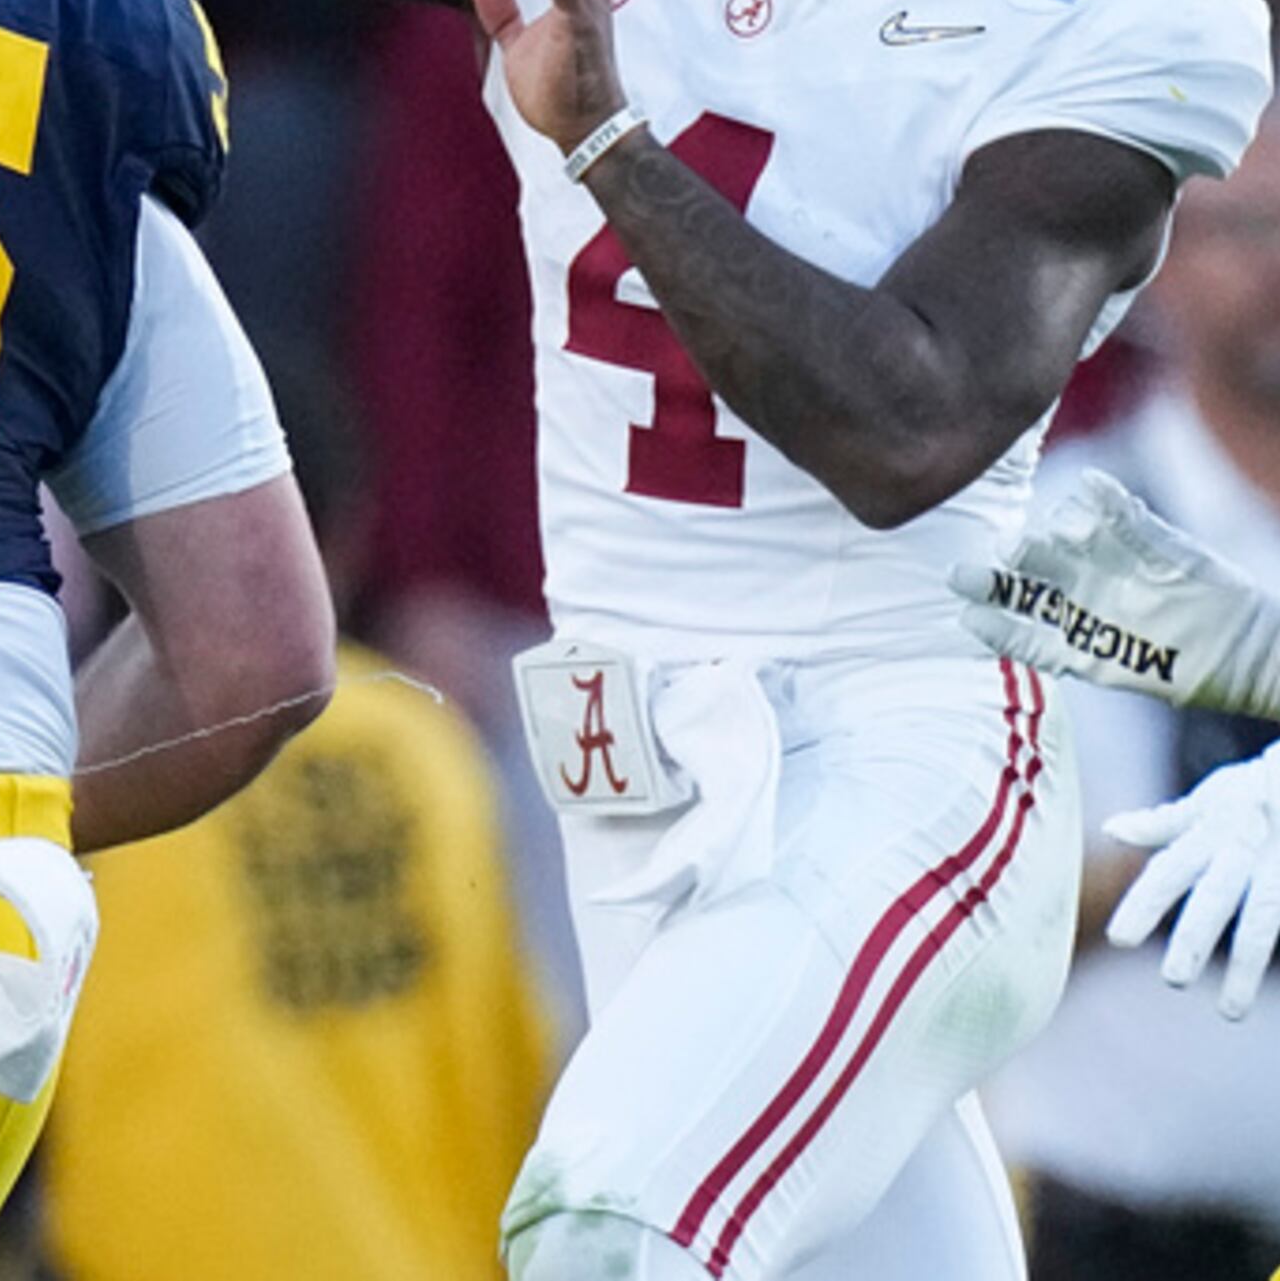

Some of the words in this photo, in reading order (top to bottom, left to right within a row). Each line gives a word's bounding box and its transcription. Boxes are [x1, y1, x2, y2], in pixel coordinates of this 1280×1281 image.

[562, 109, 775, 509] 4
[987, 568, 1180, 684] MICHIGAN
[560, 669, 629, 797] A
